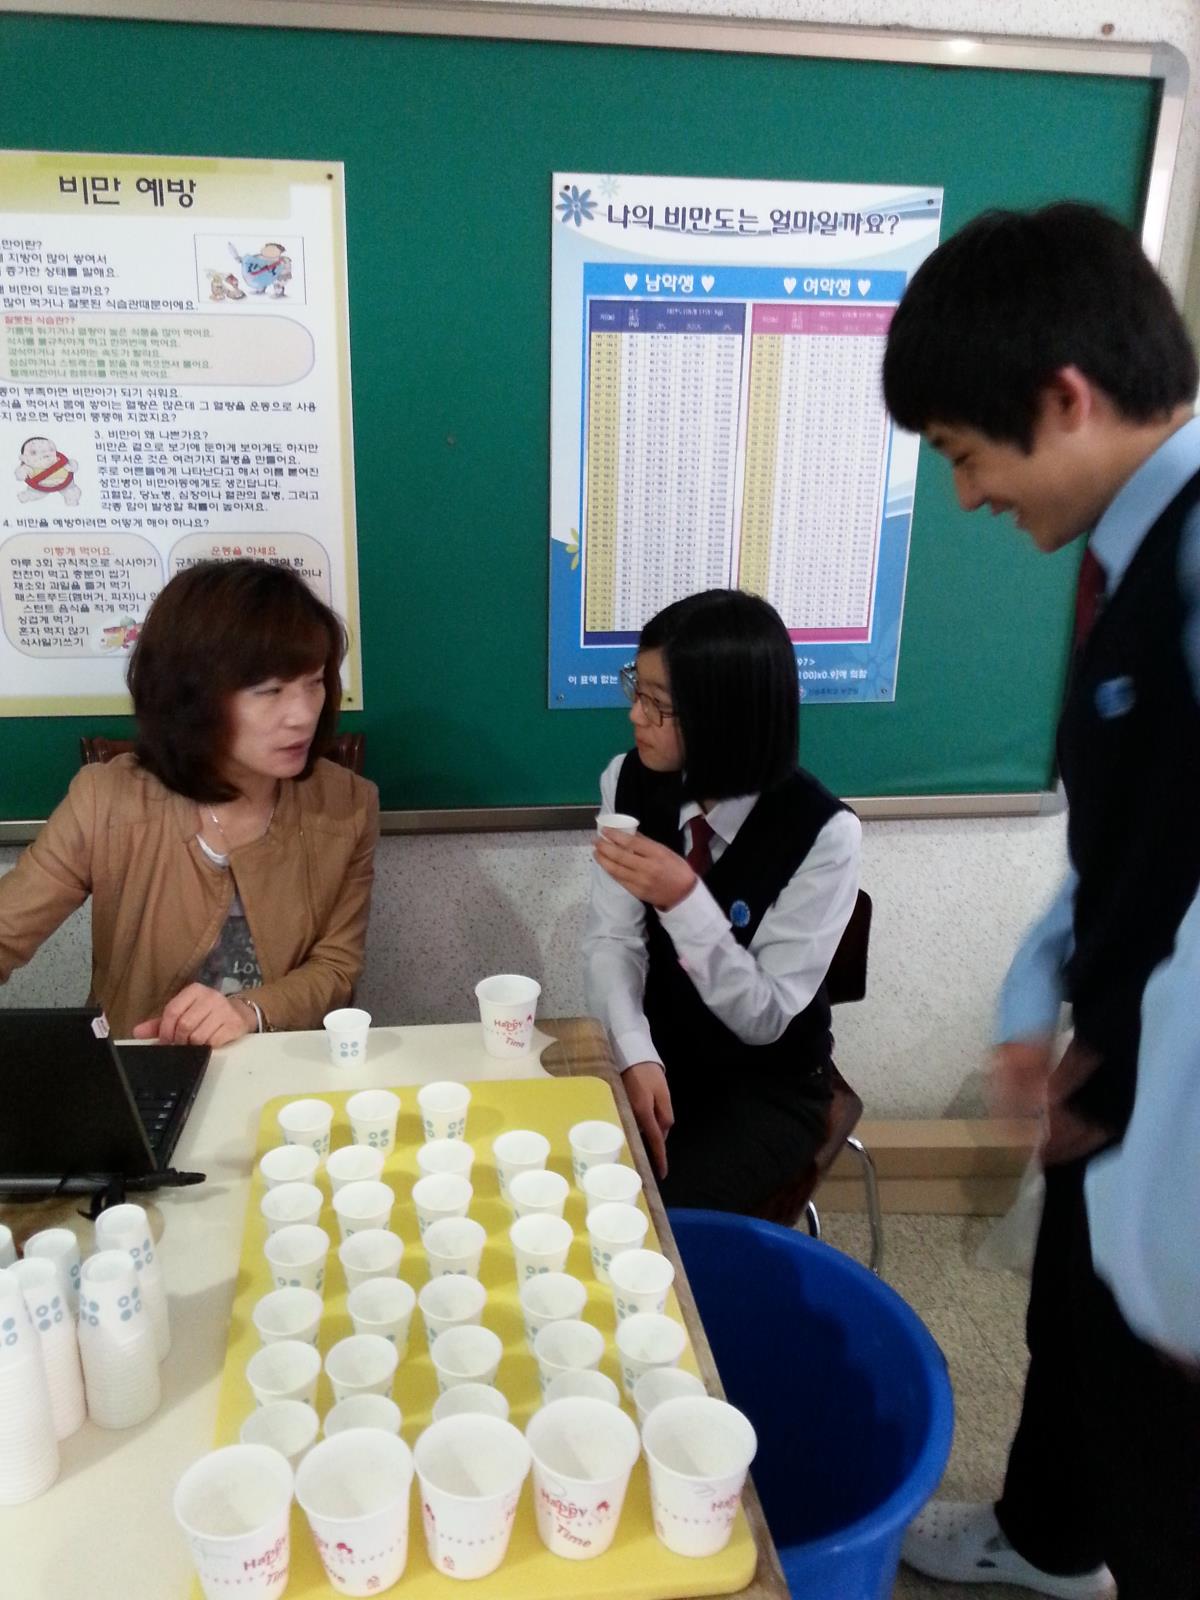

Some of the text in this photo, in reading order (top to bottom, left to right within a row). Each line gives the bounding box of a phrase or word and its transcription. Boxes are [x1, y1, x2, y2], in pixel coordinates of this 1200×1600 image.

[59, 176, 196, 208] 비만 예방
[607, 204, 900, 236] 나의 비만도는 얼마일까요?
[47, 254, 69, 265] 많이
[73, 254, 107, 265] 쌓여서
[6, 266, 119, 277] 증가한 상태를 말해요.
[645, 274, 694, 291] 남학생
[803, 277, 851, 295] 여학생
[9, 285, 110, 296] 비만이 되는걸까요?
[3, 299, 198, 311] 많이 먹거나 잘못된 식습관때문이에요.
[24, 387, 67, 398] 부족하면
[121, 387, 143, 398] 되기
[147, 387, 183, 398] 쉬워요.
[0, 400, 317, 413] 식을 먹어서 몸에 쌓이는 열량은 많은데 그 열량을 운동으로 사용
[16, 412, 48, 423] 않으면
[54, 412, 86, 423] 당연히
[90, 412, 122, 423] 뚱뚱해
[127, 412, 176, 423] 지겠지요?
[94, 430, 209, 440] 3. 비만이 왜 나쁜가요?
[96, 442, 318, 453] 비만은 겉으로 보기에 둔하게 보이게도 하지만
[97, 454, 301, 464] 더 무서운 것은 여러가지 질병을 만들어요.
[98, 466, 120, 476] 주로
[123, 466, 177, 476] 어른들에게
[181, 466, 234, 476] 나타난다고
[238, 466, 259, 476] 해서
[288, 466, 319, 476] 붙여진
[100, 478, 281, 488] 성인병이 비만아동에게도 생긴답니다.
[102, 502, 268, 512] 각종 암이 발생할 확률이 높아져요.
[3, 518, 210, 528] 4. 비만을 예방하려면 어떻게 해야 하나요?
[44, 547, 75, 556] 이렇게
[212, 546, 242, 556] 운동을
[11, 559, 157, 568] 하루 3회 규칙적으로 식사하기
[12, 570, 130, 580] 천천히 먹고 충분히 씹기
[13, 582, 131, 591] 채소와 과일을 즐겨 먹기
[23, 605, 140, 614] 스턴트 음식을 적게 먹기
[18, 616, 74, 626] 싱겁게 먹기
[19, 627, 89, 636] 혼자 먹지 않기
[20, 638, 84, 647] 식사일기쓰기
[494, 1018, 523, 1032] Happy
[541, 1488, 588, 1519] Happy
[557, 1524, 592, 1548] Time
